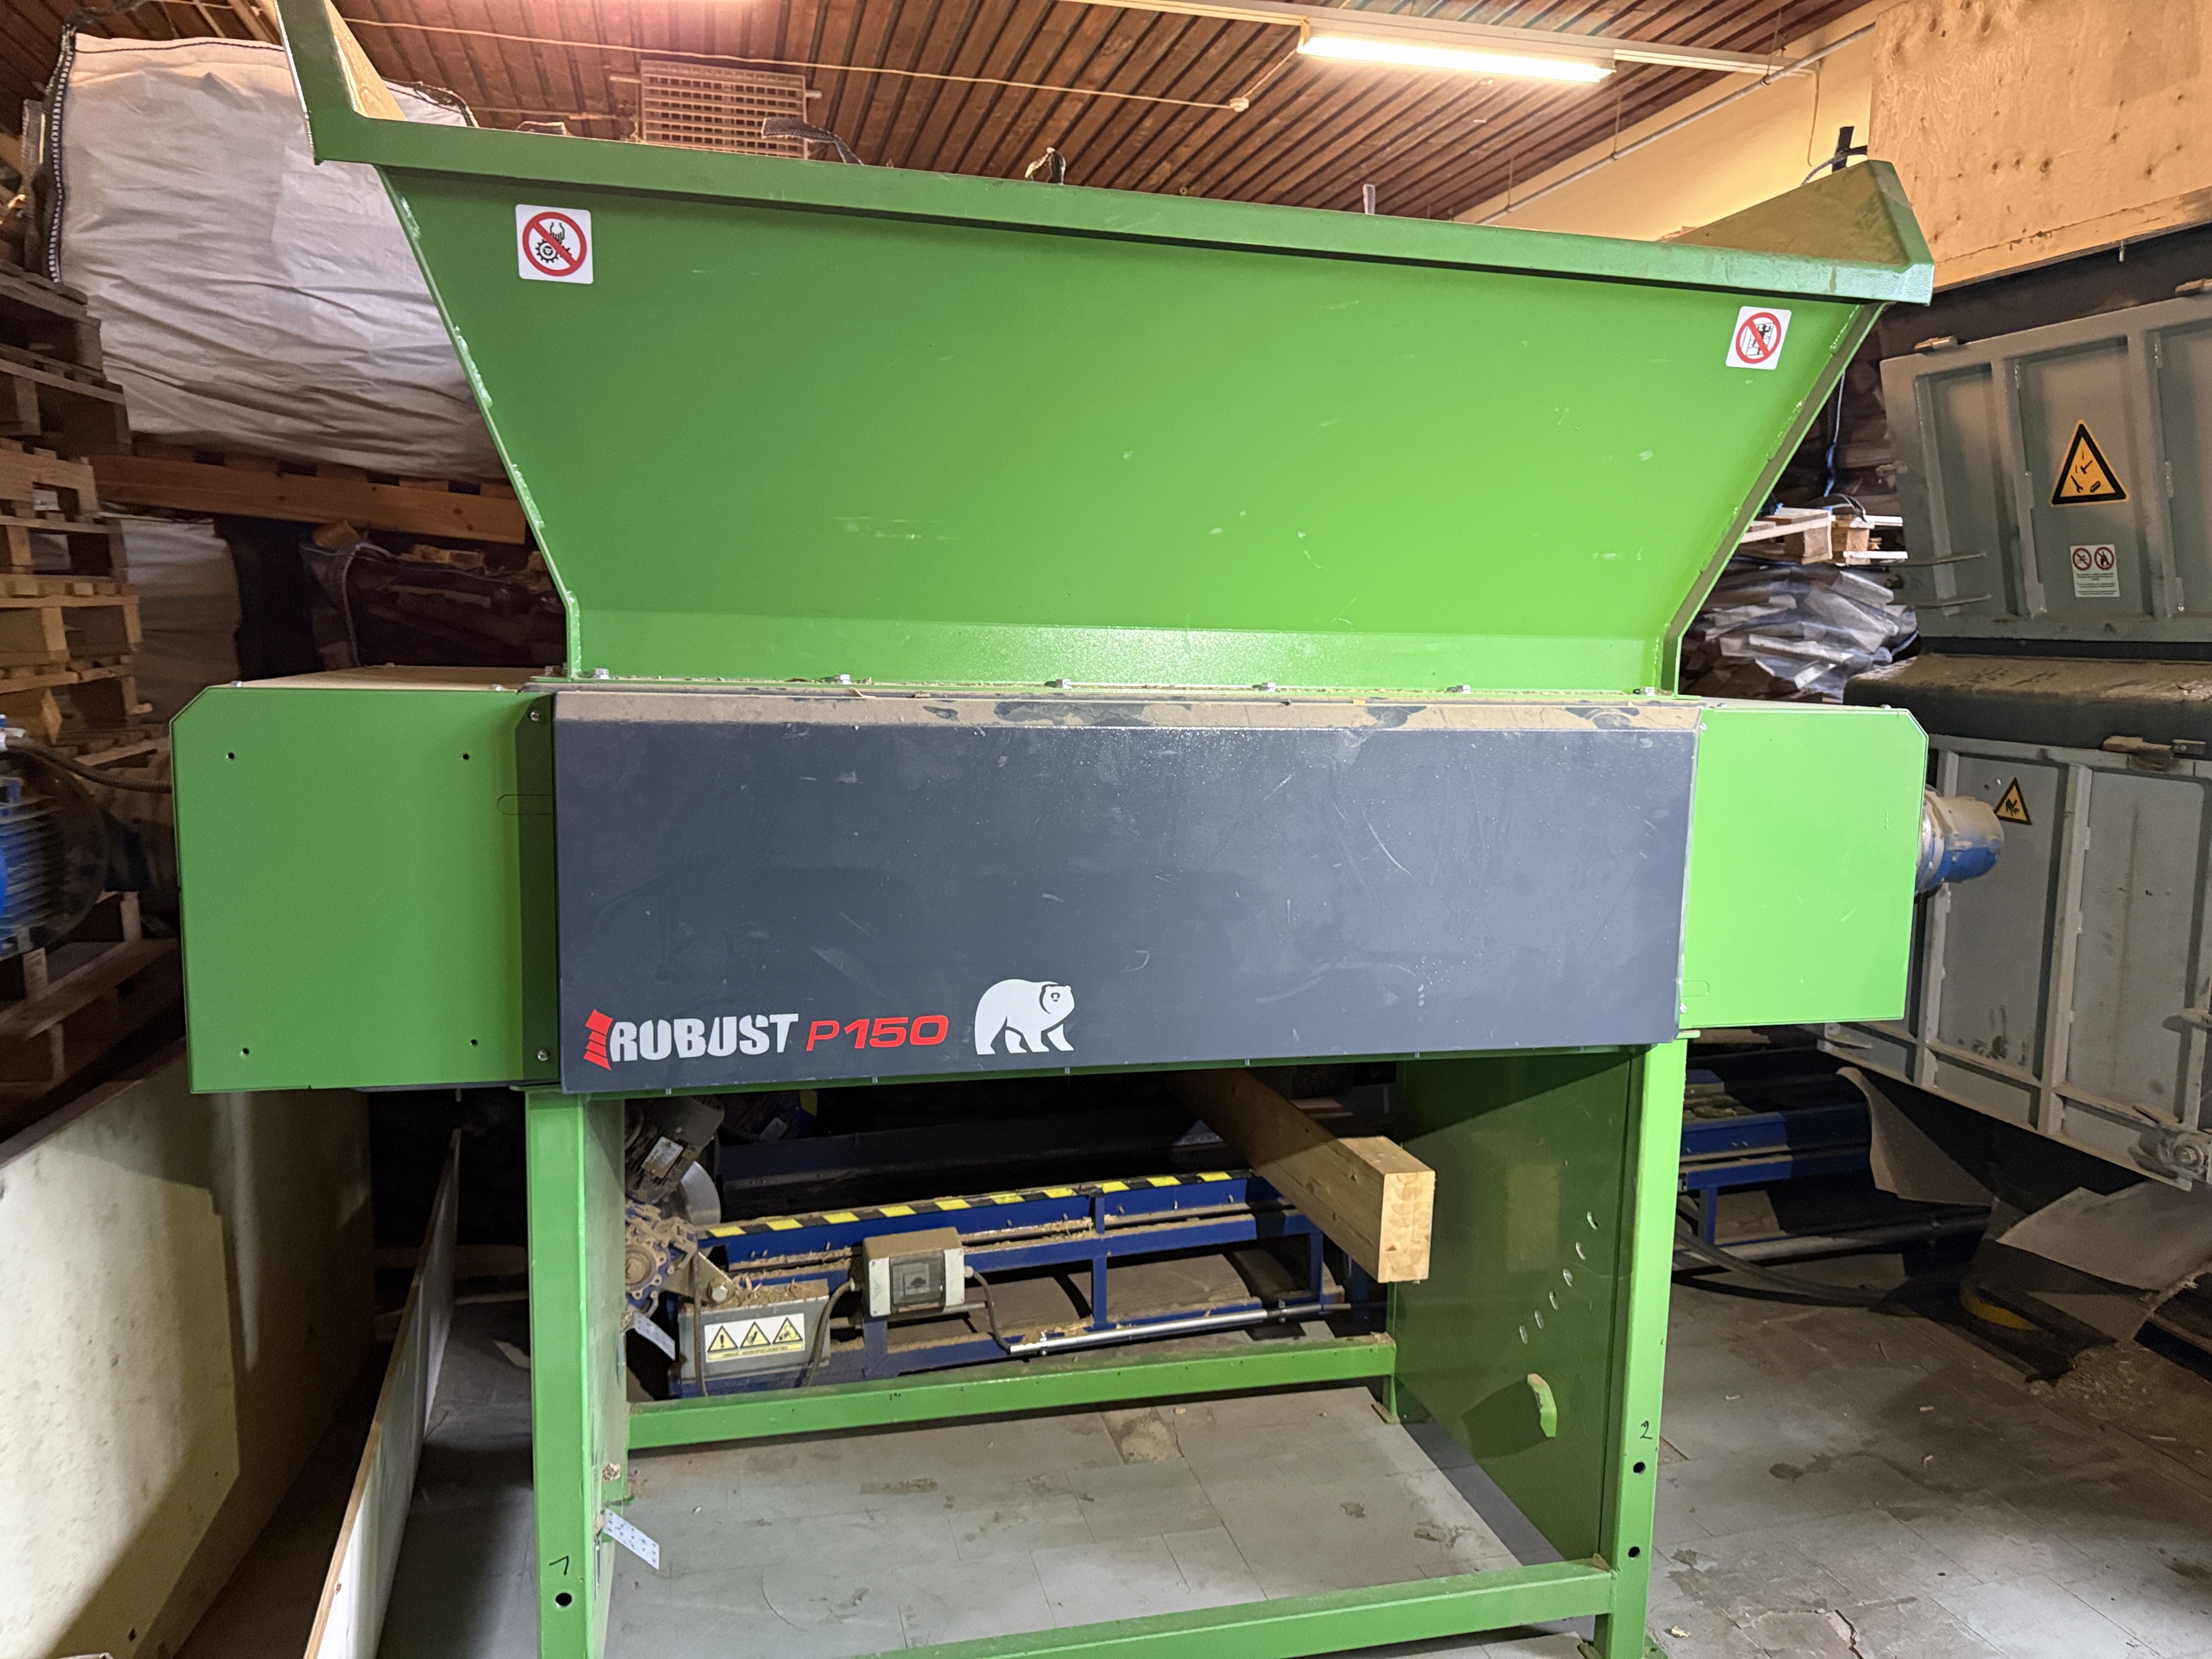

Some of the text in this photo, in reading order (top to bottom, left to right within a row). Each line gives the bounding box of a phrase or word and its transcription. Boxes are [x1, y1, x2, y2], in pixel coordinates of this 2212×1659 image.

[609, 1013, 949, 1062] ROBUST P150
[1639, 1420, 1654, 1440] 2
